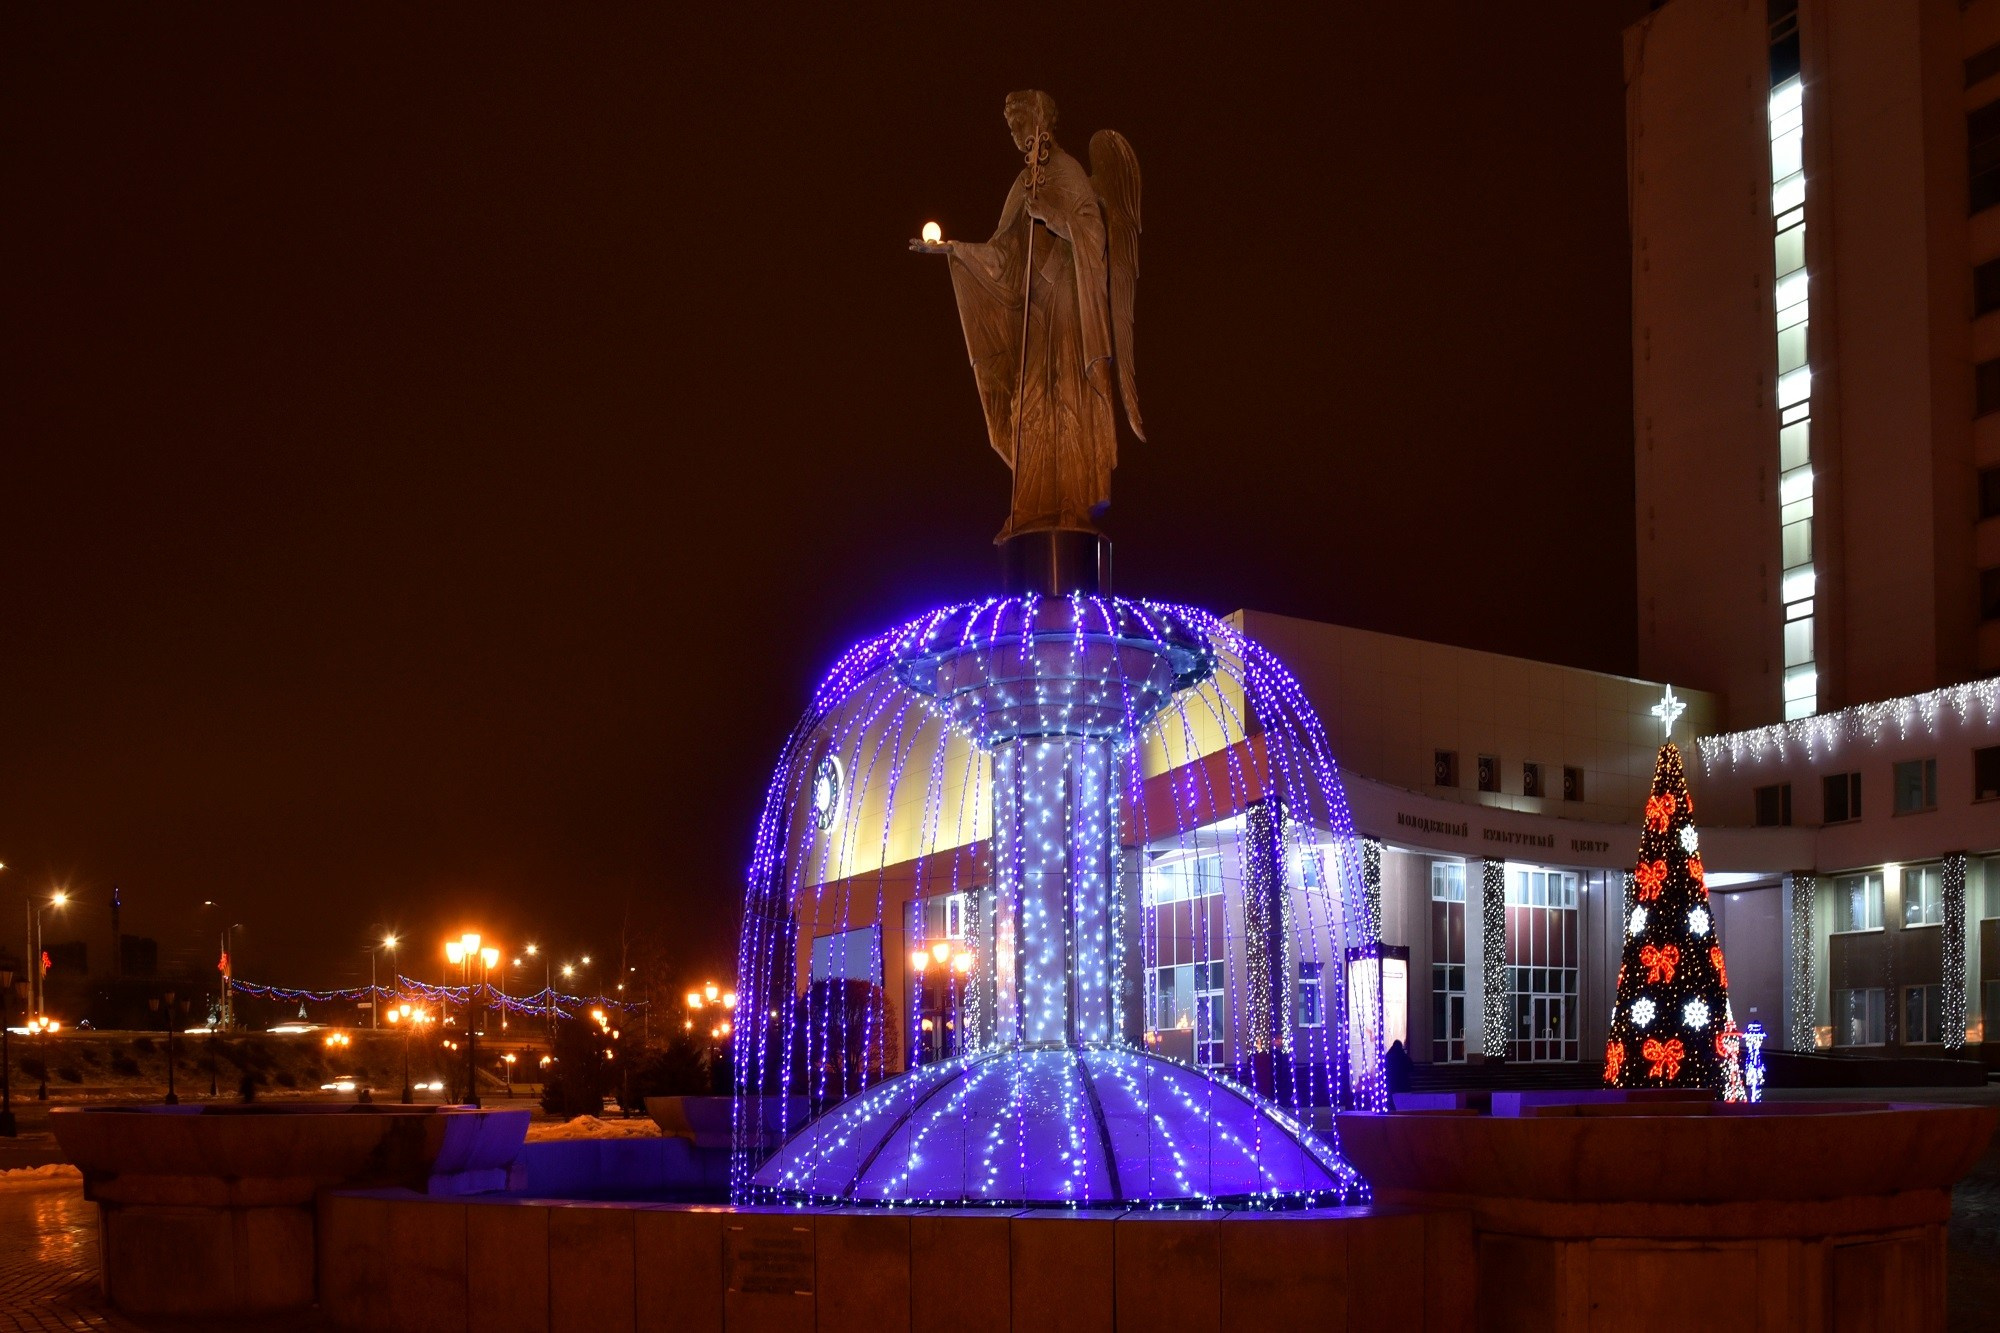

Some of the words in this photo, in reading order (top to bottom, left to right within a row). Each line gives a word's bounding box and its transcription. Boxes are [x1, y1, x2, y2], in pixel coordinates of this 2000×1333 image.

[1397, 812, 1468, 837] МОЛОДЕЖНЫЙ
[1483, 828, 1554, 848] КУЛЬТУРНЫЙ
[1571, 839, 1610, 853] ЦЕНТР
